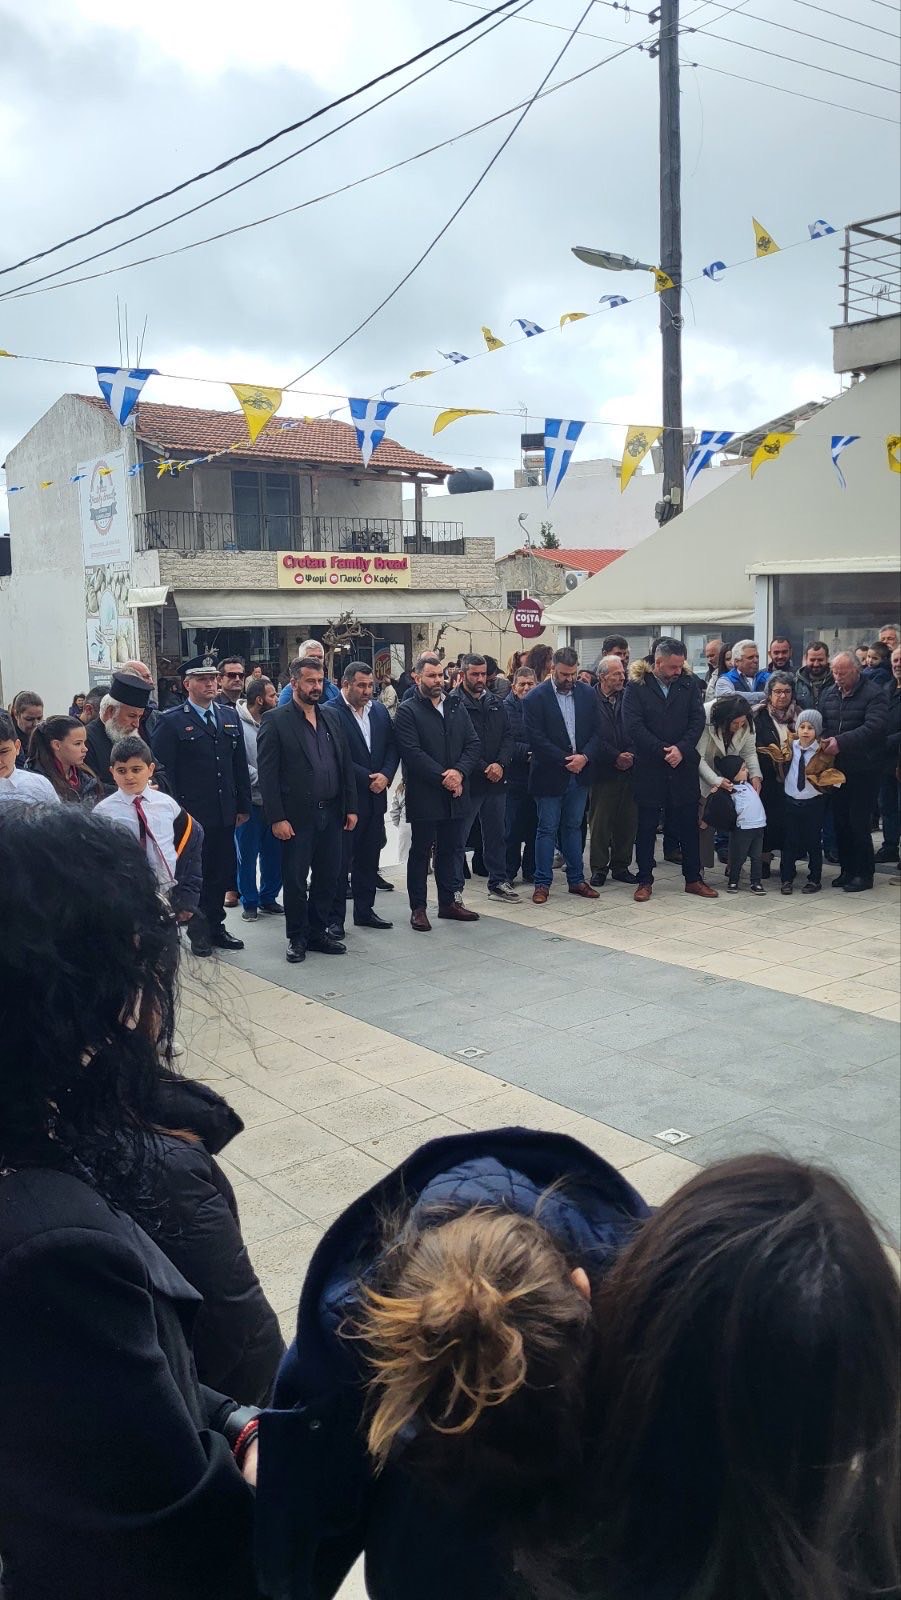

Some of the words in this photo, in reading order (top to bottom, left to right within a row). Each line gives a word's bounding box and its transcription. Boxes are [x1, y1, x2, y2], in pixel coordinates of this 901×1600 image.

[283, 555, 327, 569] Cretan
[330, 556, 371, 572] Family
[374, 557, 408, 570] Bread
[305, 573, 327, 584] Ψωμί
[340, 573, 362, 583] Γλυκό
[374, 574, 398, 584] Καφές
[515, 614, 540, 623] COSTA
